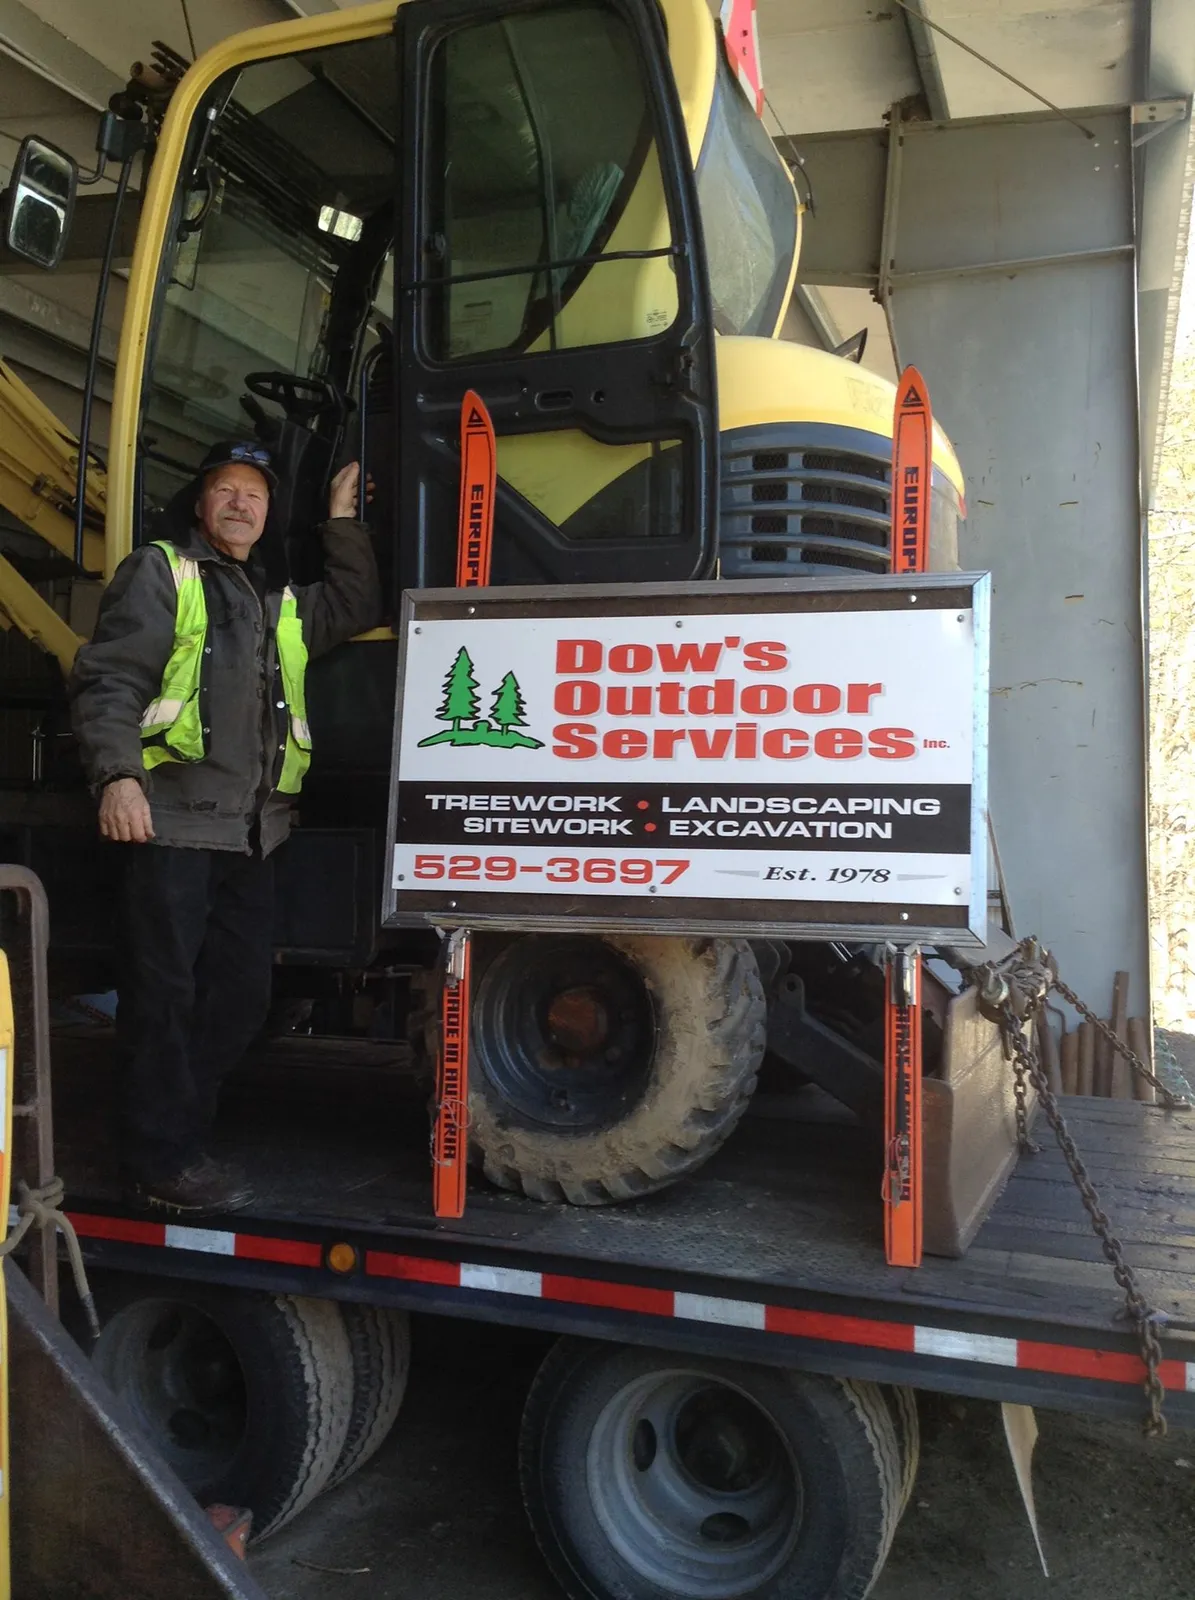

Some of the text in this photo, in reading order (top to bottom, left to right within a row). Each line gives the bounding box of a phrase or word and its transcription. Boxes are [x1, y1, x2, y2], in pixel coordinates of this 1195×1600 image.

[902, 466, 919, 574] EUROP
[555, 636, 788, 674] Dow's
[554, 679, 882, 716] Outdoor
[552, 722, 951, 759] Services Inc.
[425, 794, 941, 816] TREEWORK LANDSCAPING
[463, 817, 892, 839] SITEWORK EXCAVATION
[413, 854, 690, 885] 529-3697
[762, 866, 891, 884] Est. 1978
[445, 1043, 459, 1063] IN
